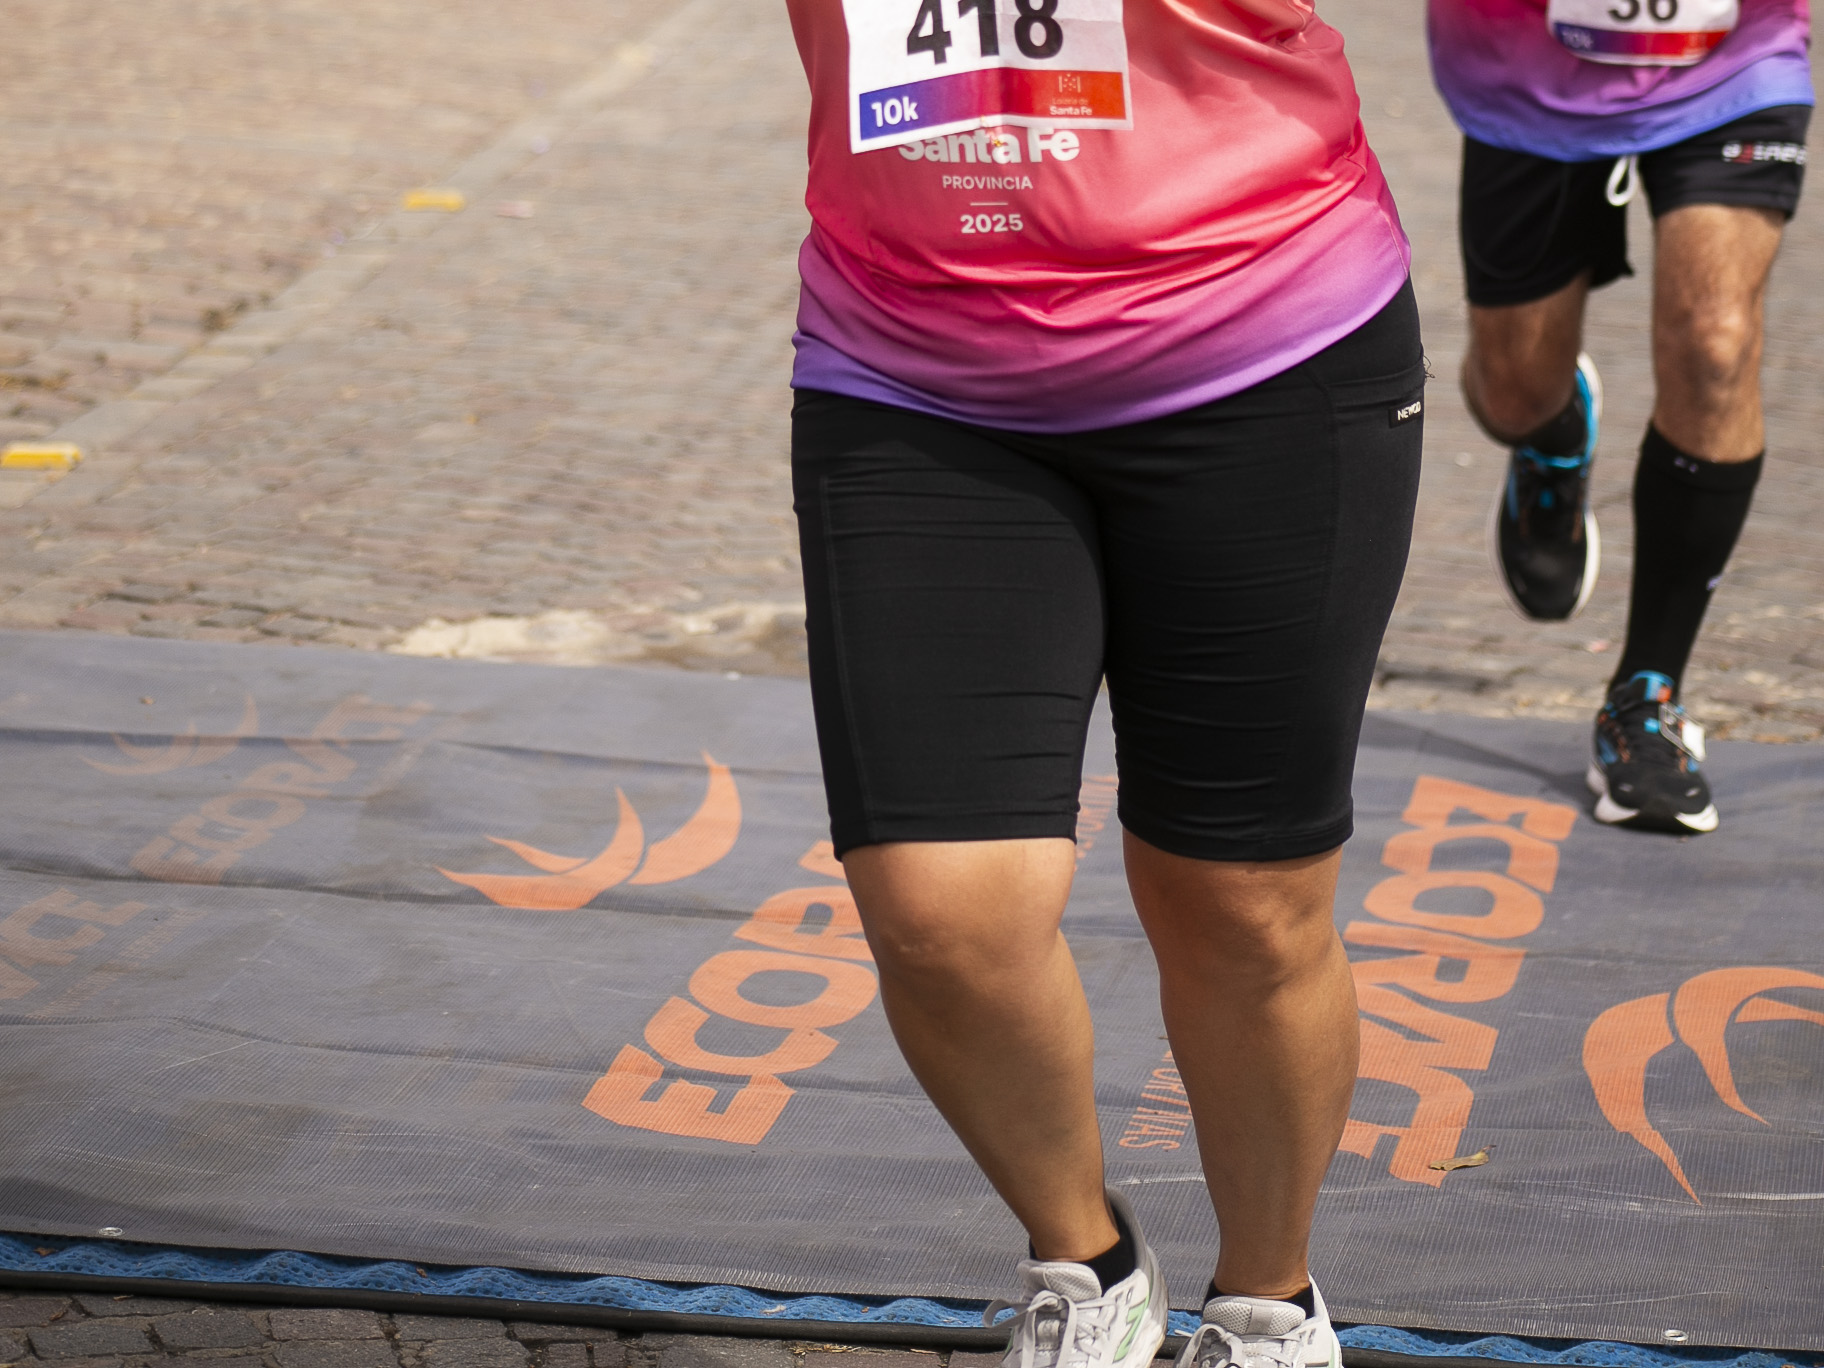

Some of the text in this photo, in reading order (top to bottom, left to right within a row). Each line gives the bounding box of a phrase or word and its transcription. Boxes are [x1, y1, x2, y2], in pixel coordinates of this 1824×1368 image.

[871, 96, 919, 128] 10k
[1049, 105, 1080, 116] Santa
[1026, 126, 1080, 164] Fe
[941, 175, 1033, 191] PROVINCIA
[960, 214, 1024, 234] 2025
